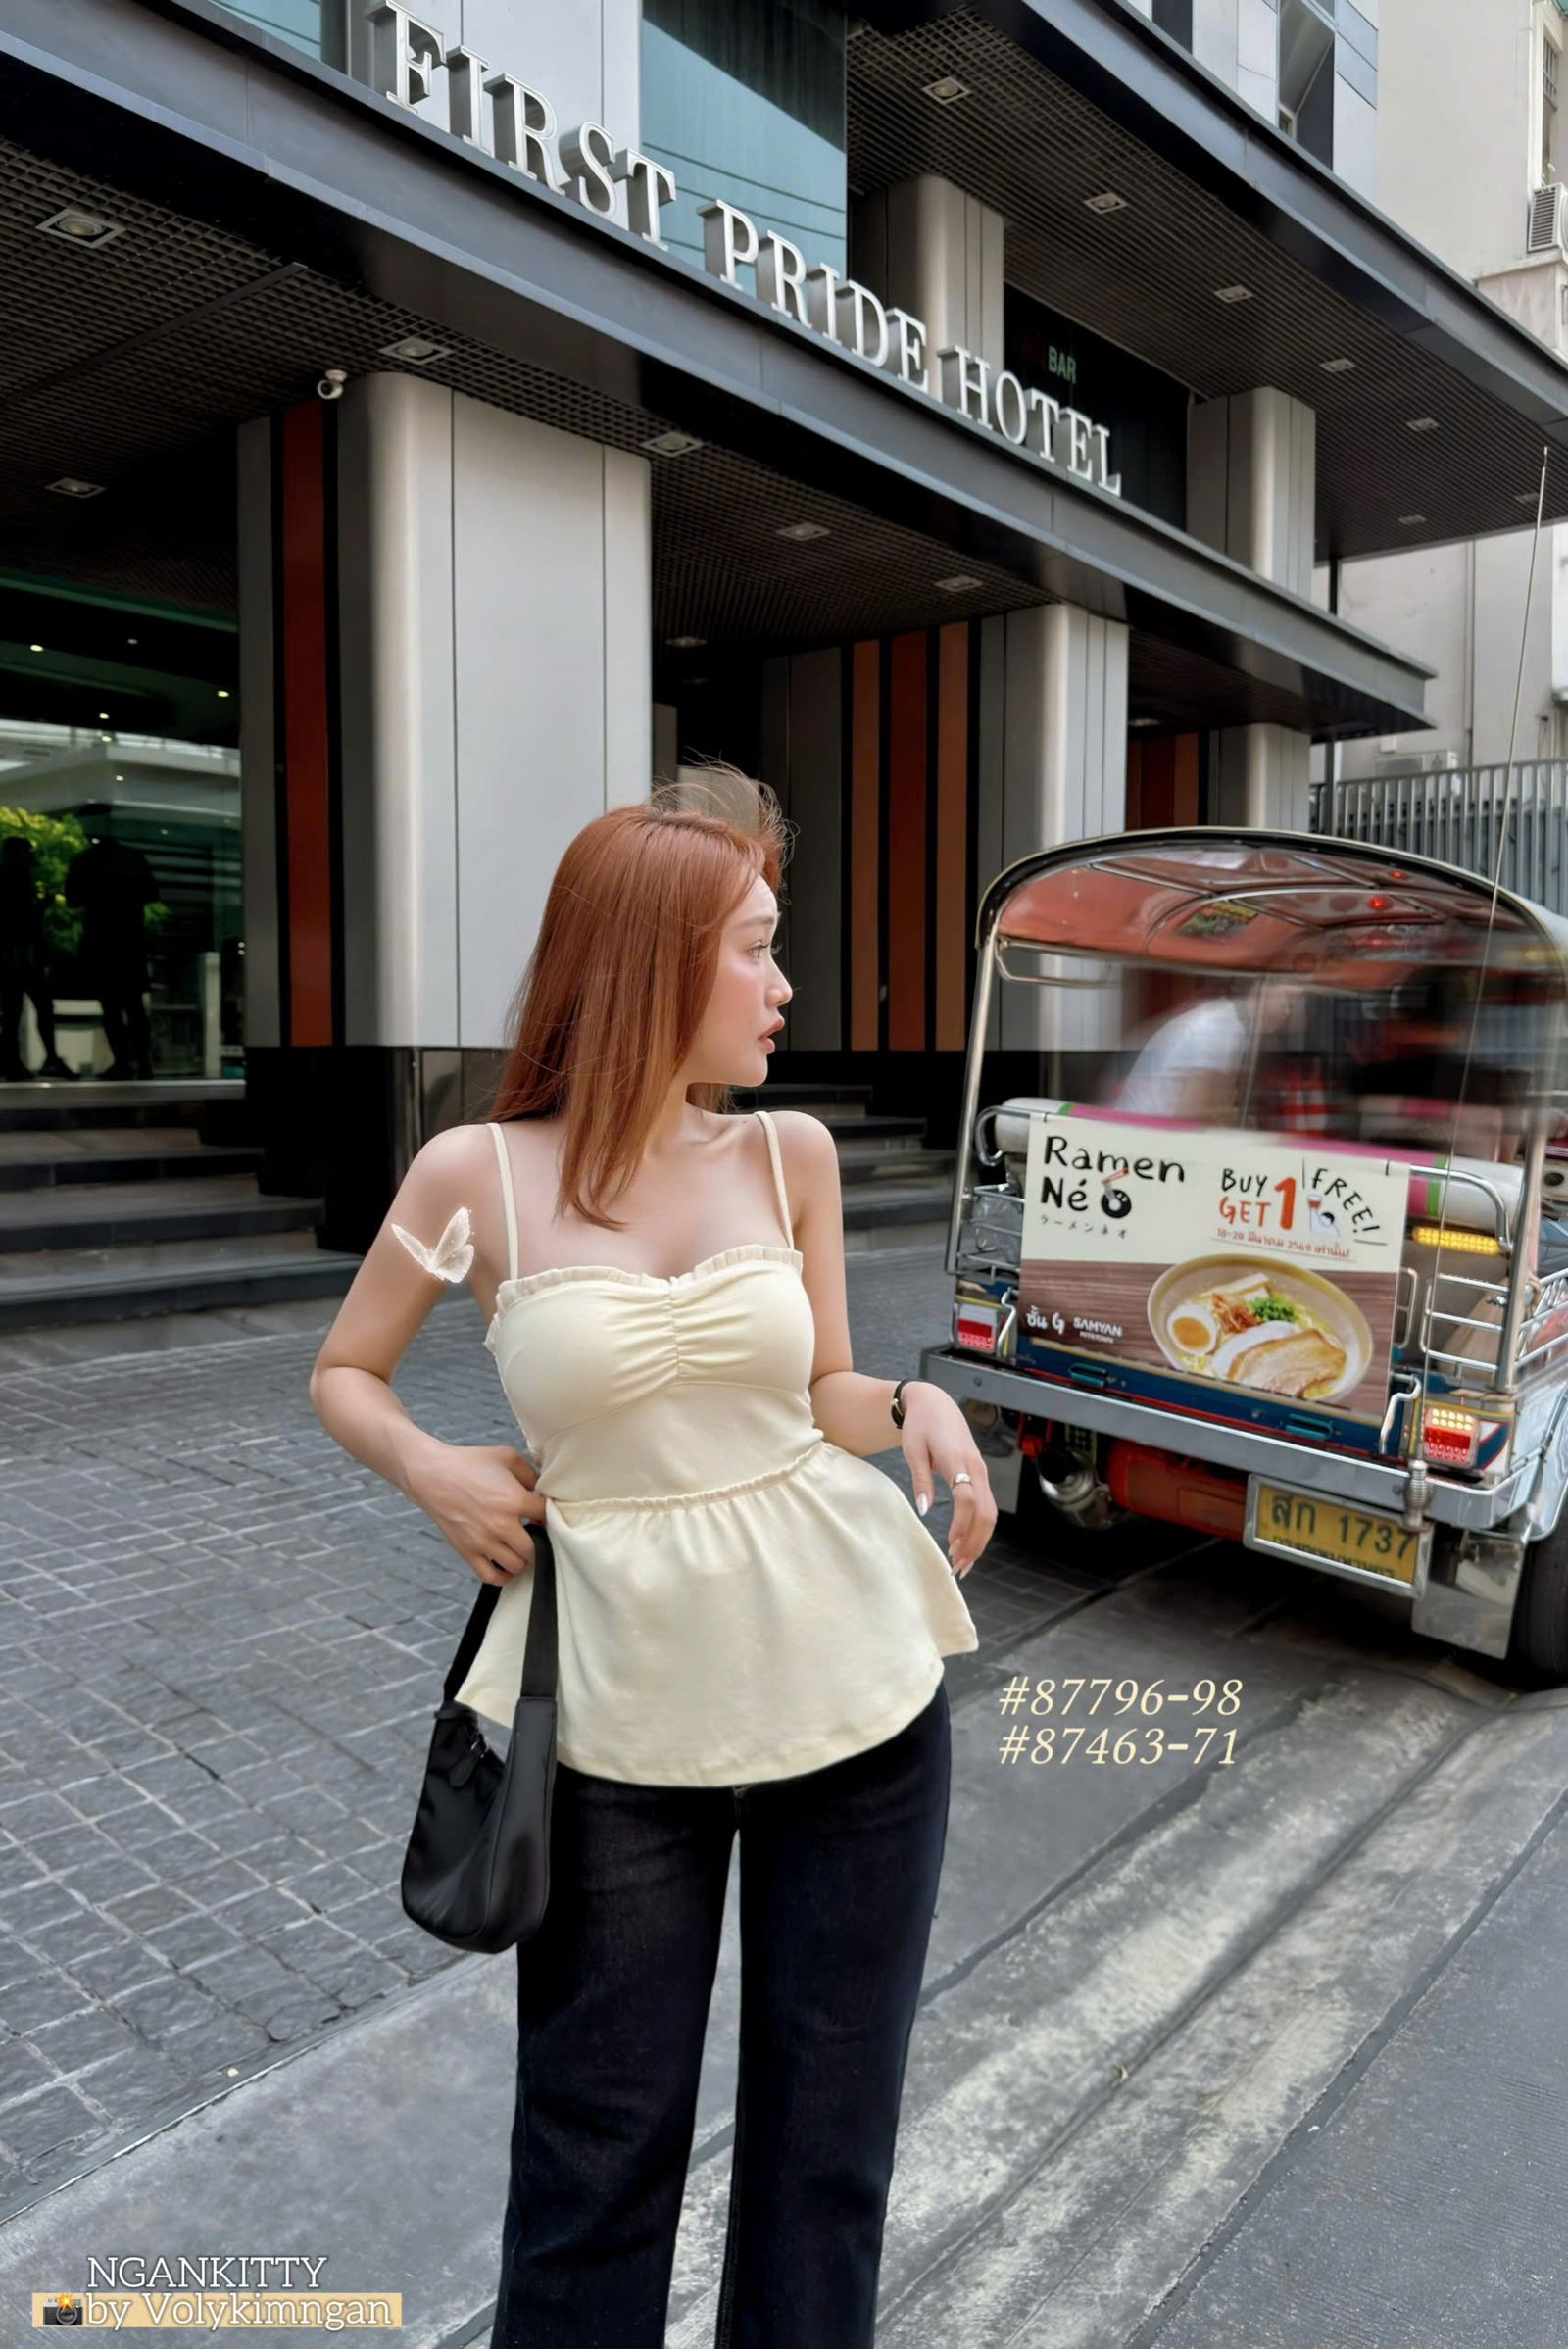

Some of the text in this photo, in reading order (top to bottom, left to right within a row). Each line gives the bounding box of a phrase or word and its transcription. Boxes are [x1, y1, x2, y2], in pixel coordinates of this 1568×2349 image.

[368, 0, 1121, 497] FIRST PRIDE HOTEL
[1048, 345, 1077, 384] BAR
[1044, 1136, 1185, 1184] Ramen
[1221, 1167, 1268, 1197] BUY
[1218, 1176, 1297, 1231] GET 1
[1311, 1167, 1381, 1235] FREE!
[1051, 1311, 1066, 1336] G
[1072, 1316, 1124, 1338] SAMYAN
[1337, 1514, 1418, 1560] 1737
